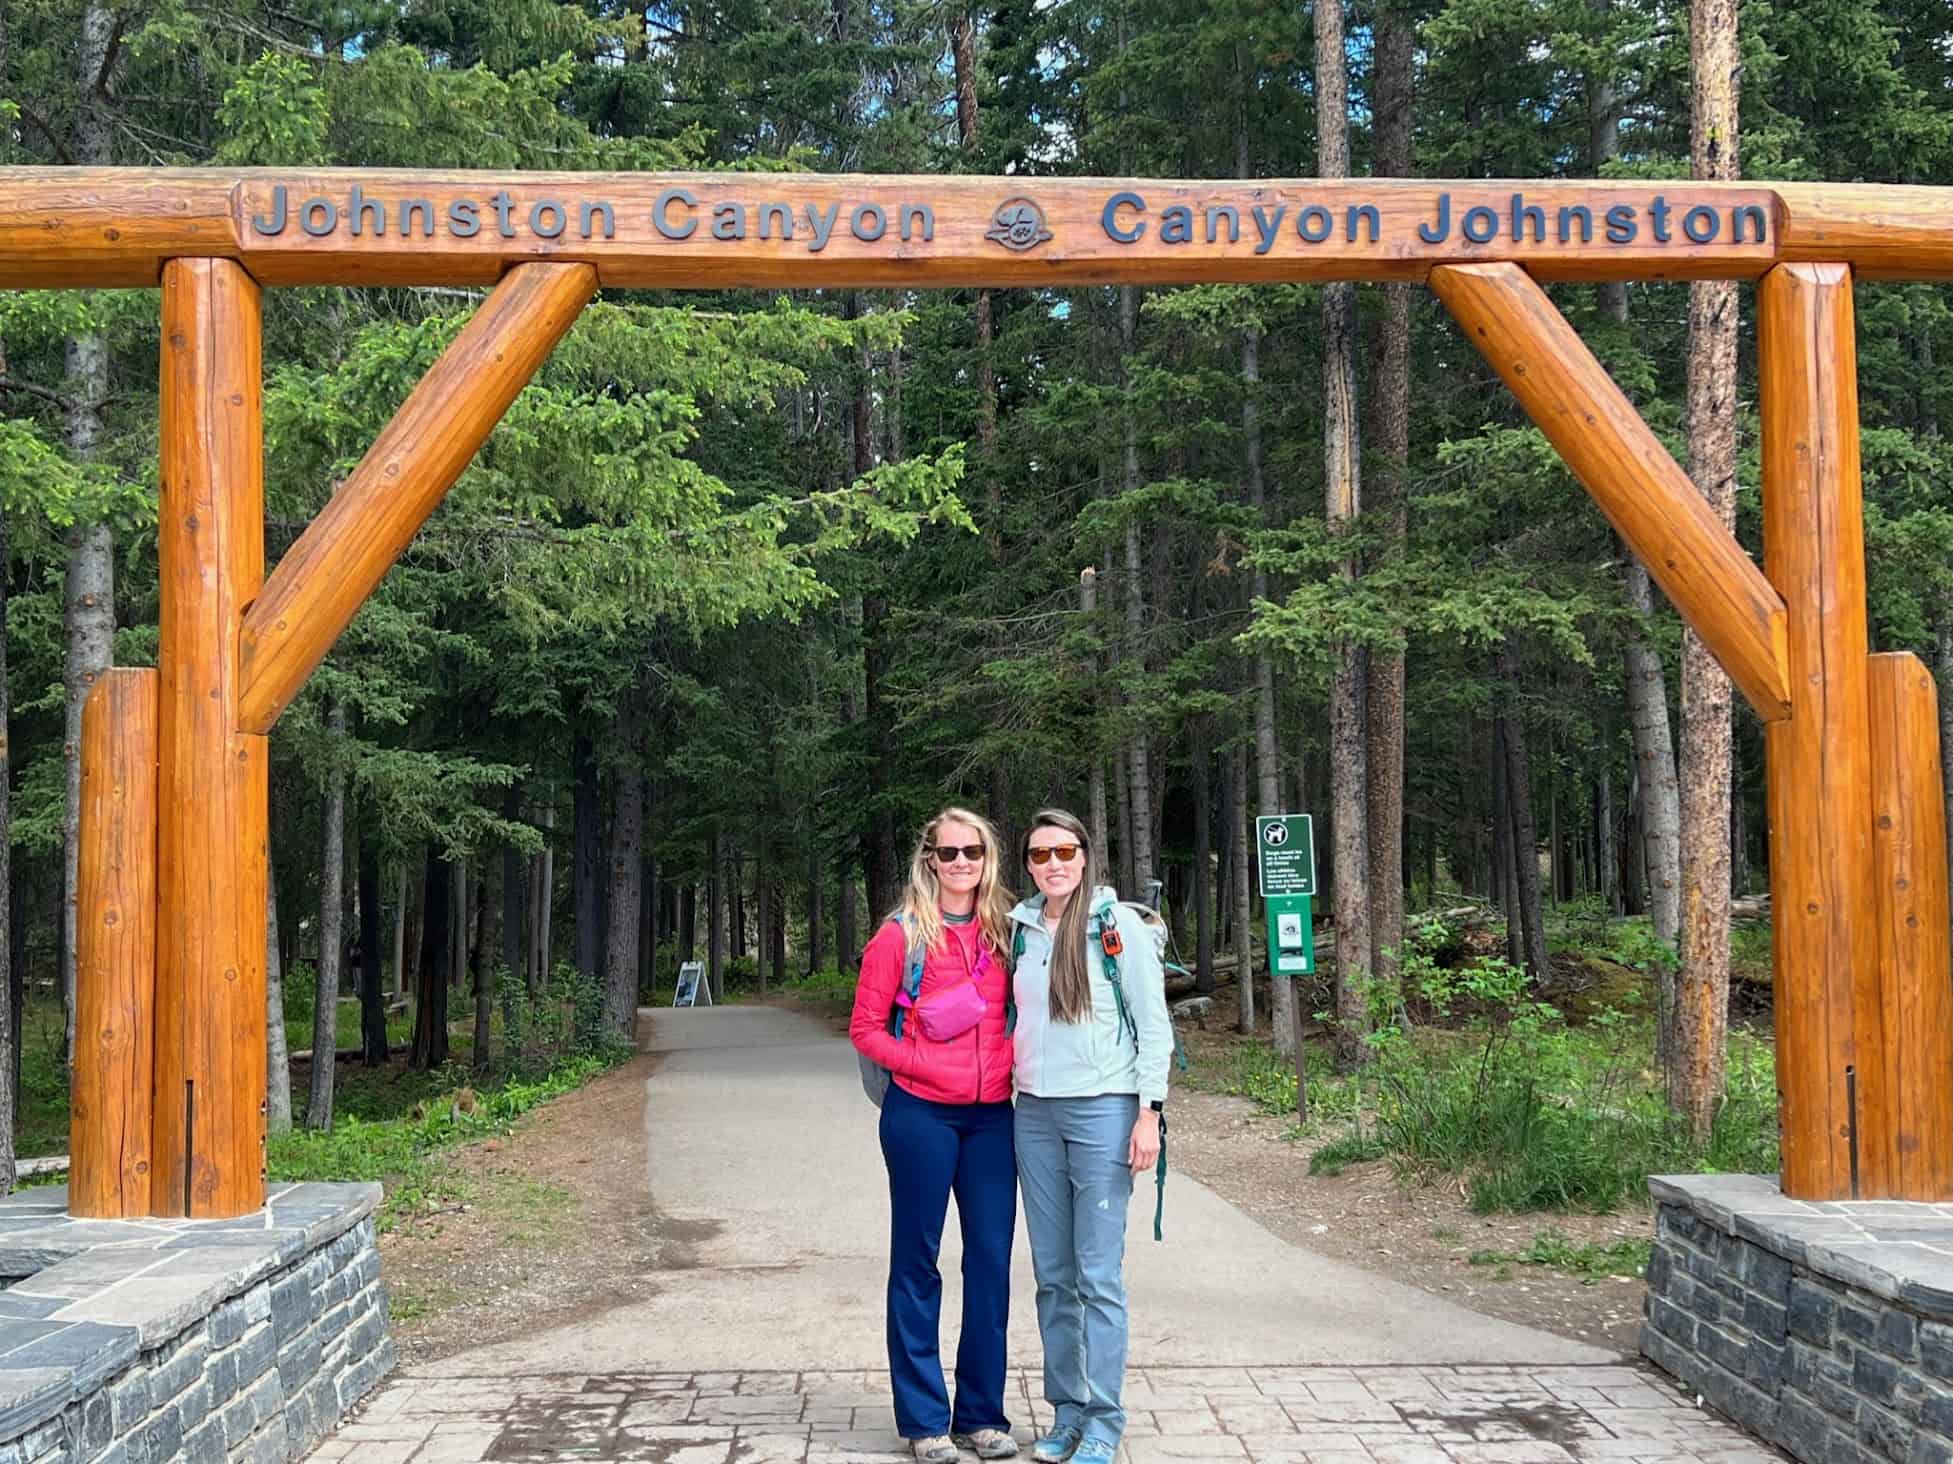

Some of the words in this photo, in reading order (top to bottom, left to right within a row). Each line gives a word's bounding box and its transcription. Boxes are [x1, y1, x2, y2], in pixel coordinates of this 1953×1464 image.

[253, 185, 615, 239] Johnston
[652, 188, 934, 252] Canyon
[1101, 191, 1381, 255] Canyon
[1418, 192, 1766, 243] Johnston
